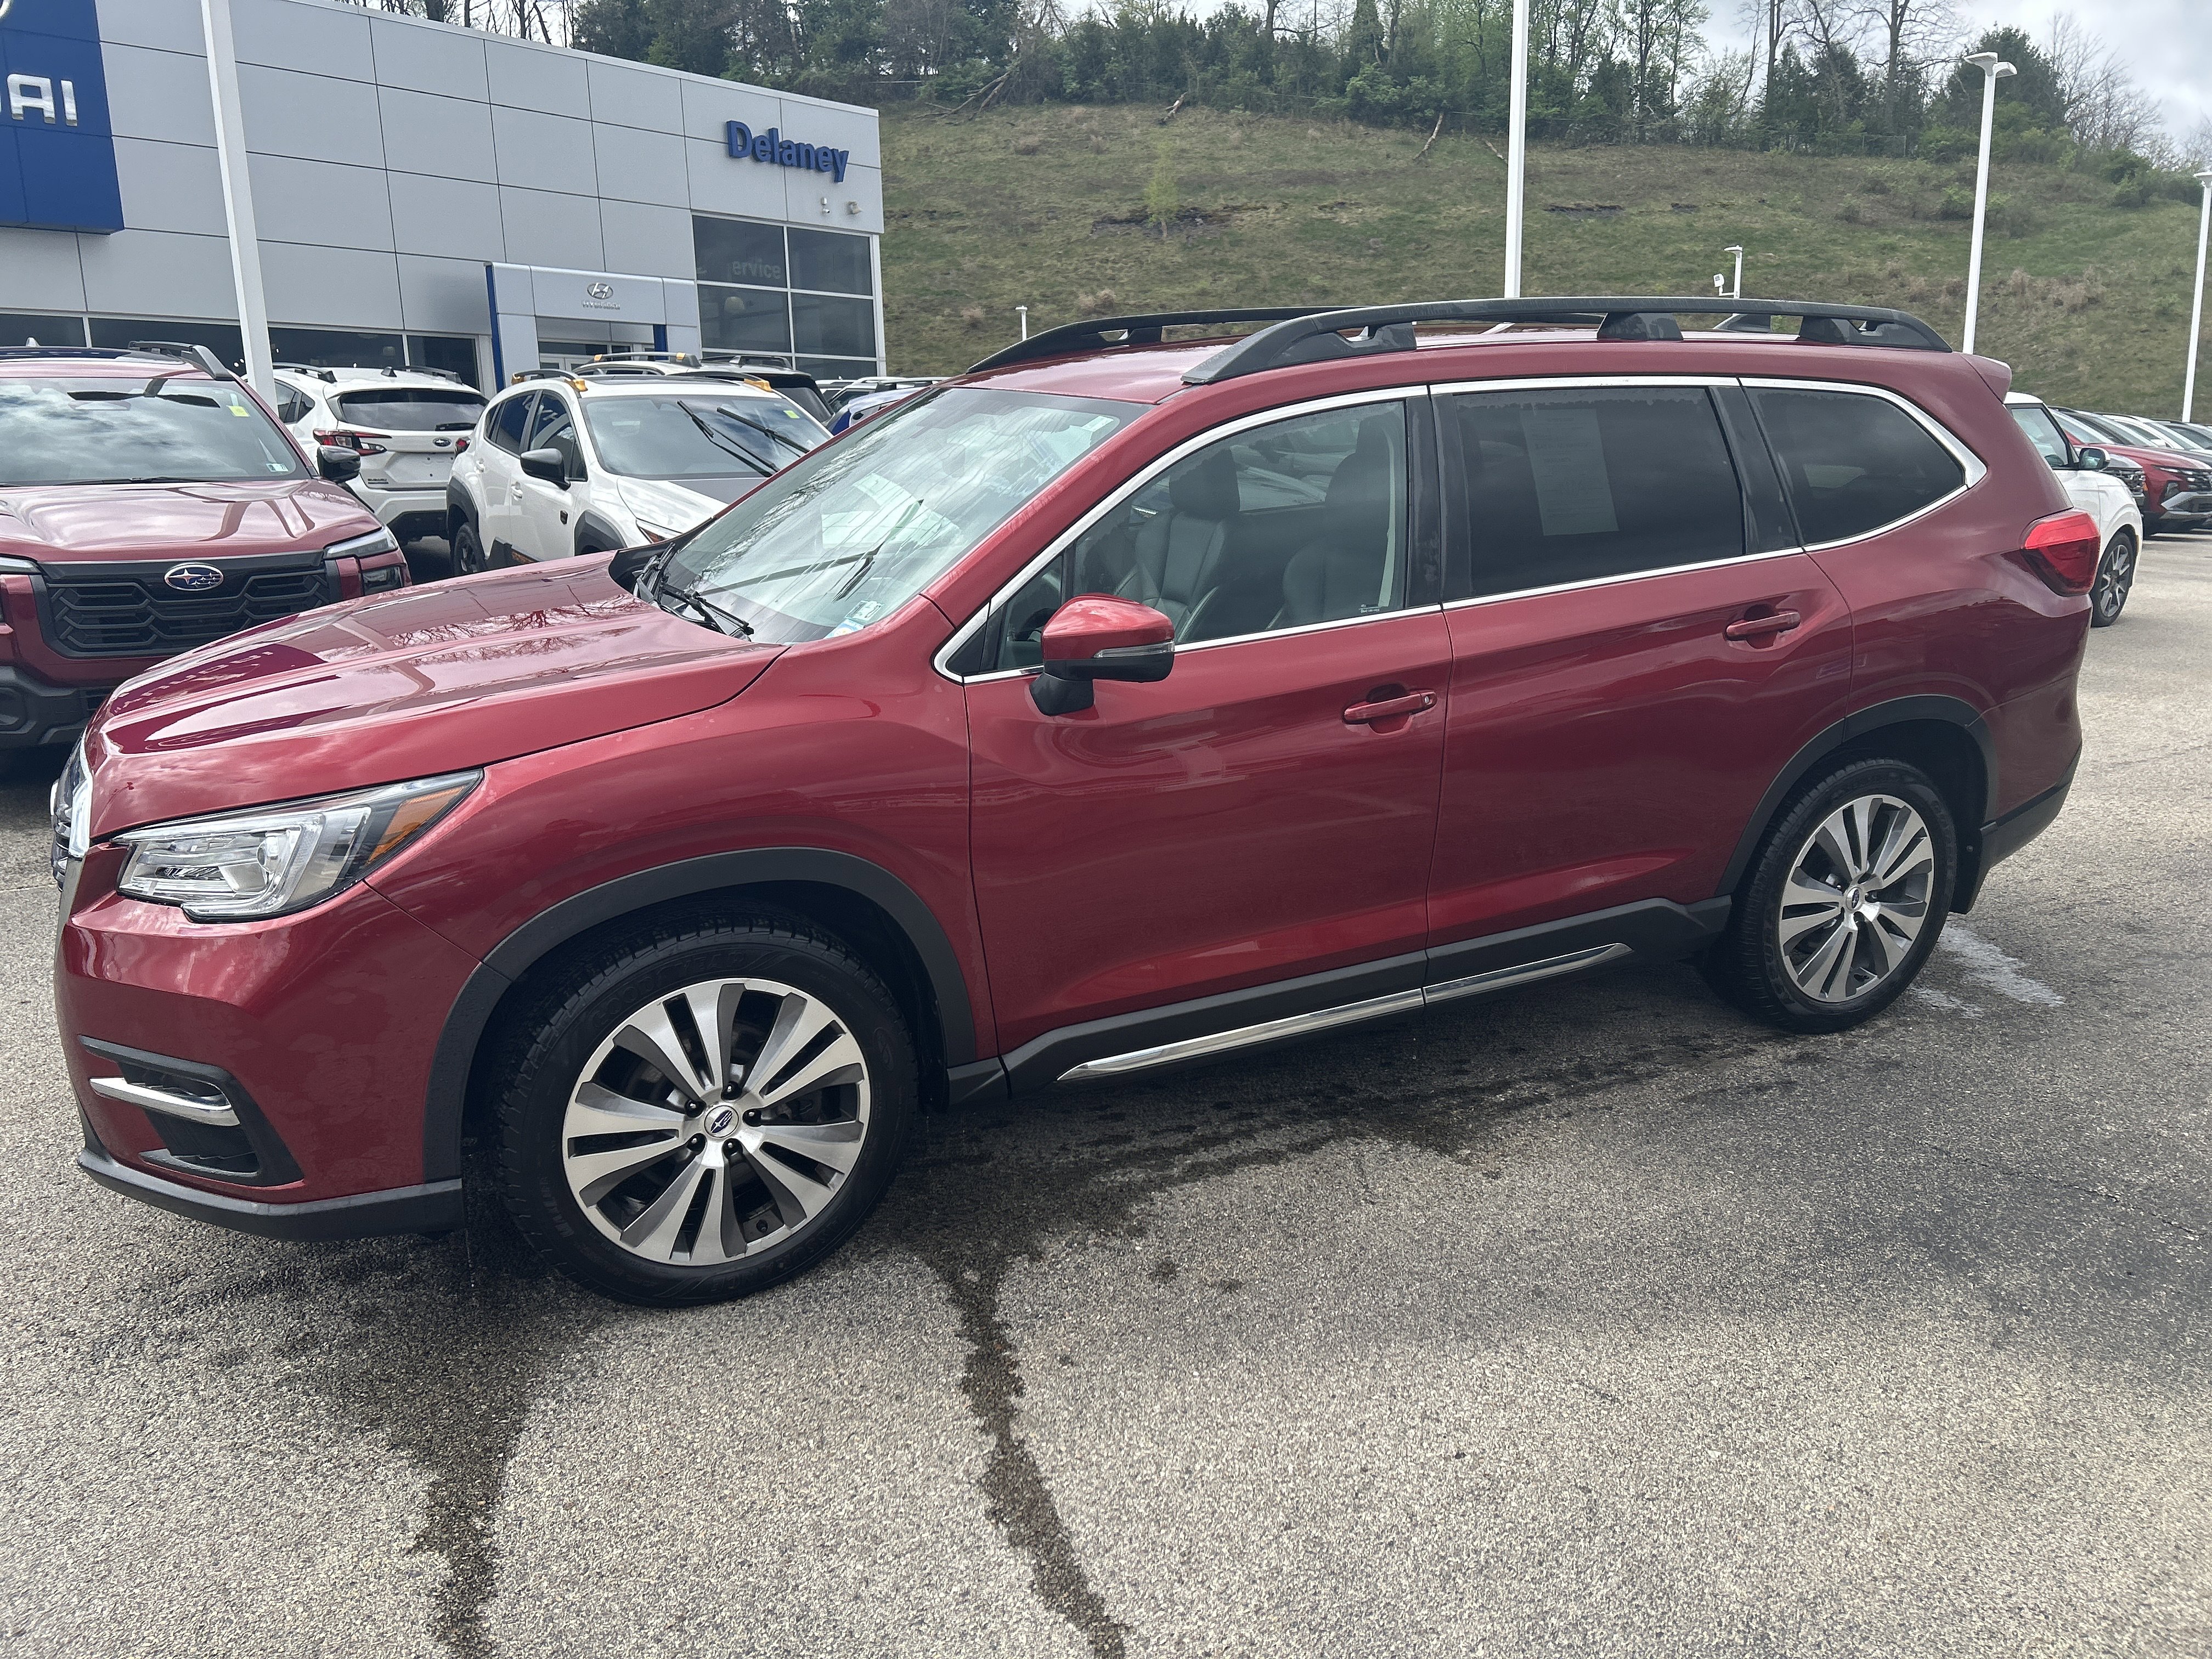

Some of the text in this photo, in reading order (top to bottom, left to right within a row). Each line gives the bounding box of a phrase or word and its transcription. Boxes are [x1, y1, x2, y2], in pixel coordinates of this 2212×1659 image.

[0, 74, 78, 127] AI
[726, 120, 849, 183] Delaney
[731, 258, 782, 279] ervice
